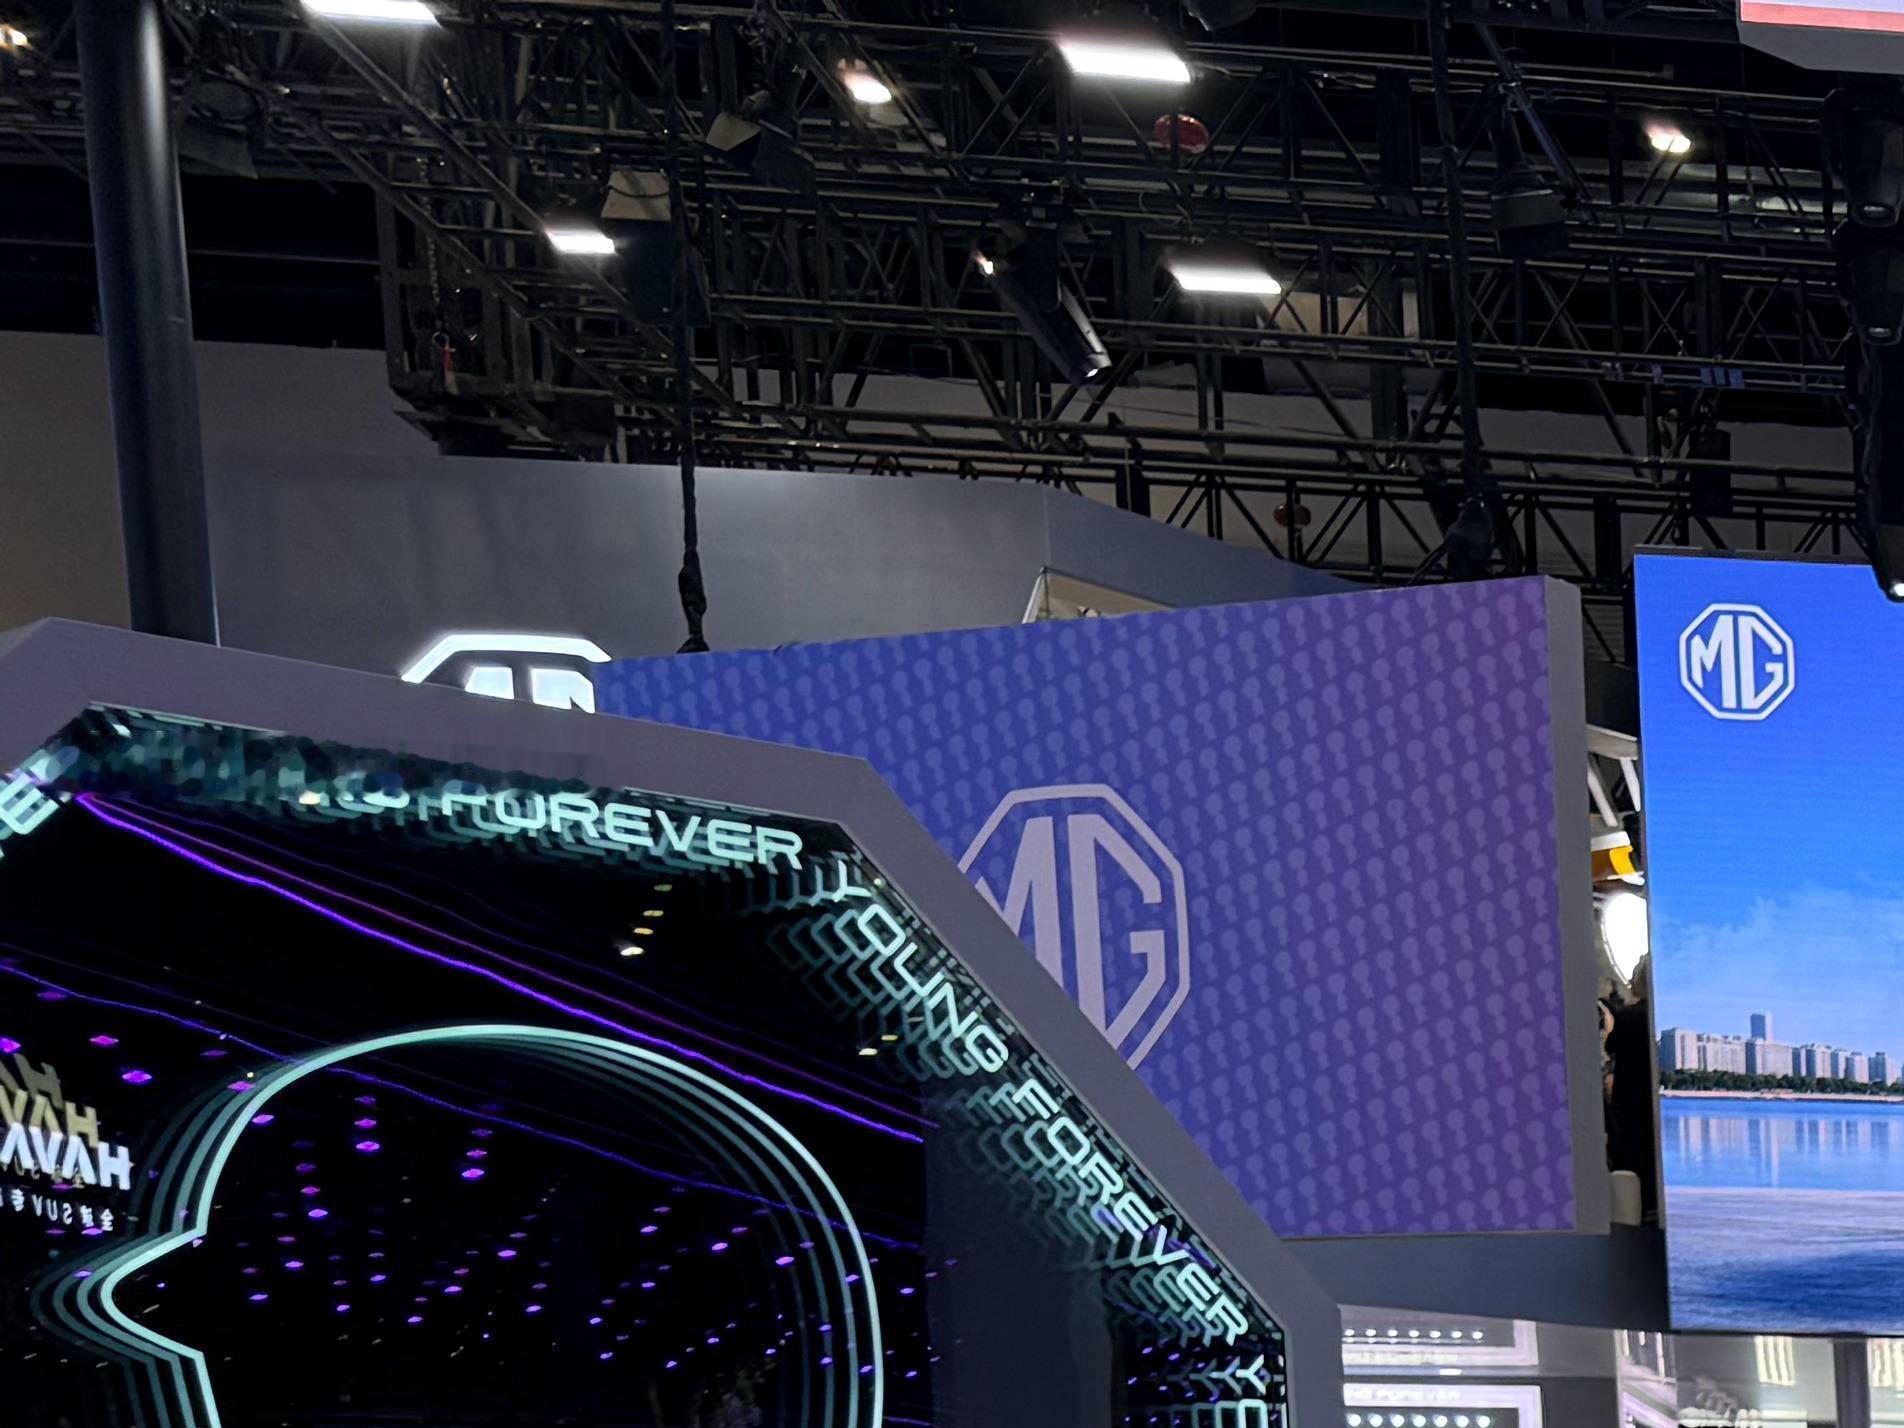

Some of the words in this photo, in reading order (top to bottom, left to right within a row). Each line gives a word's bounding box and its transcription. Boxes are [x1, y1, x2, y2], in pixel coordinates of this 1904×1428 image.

[1690, 614, 1784, 710] MG
[832, 861, 1008, 1071] YOUNG
[1012, 1079, 1248, 1345] FOREVER
